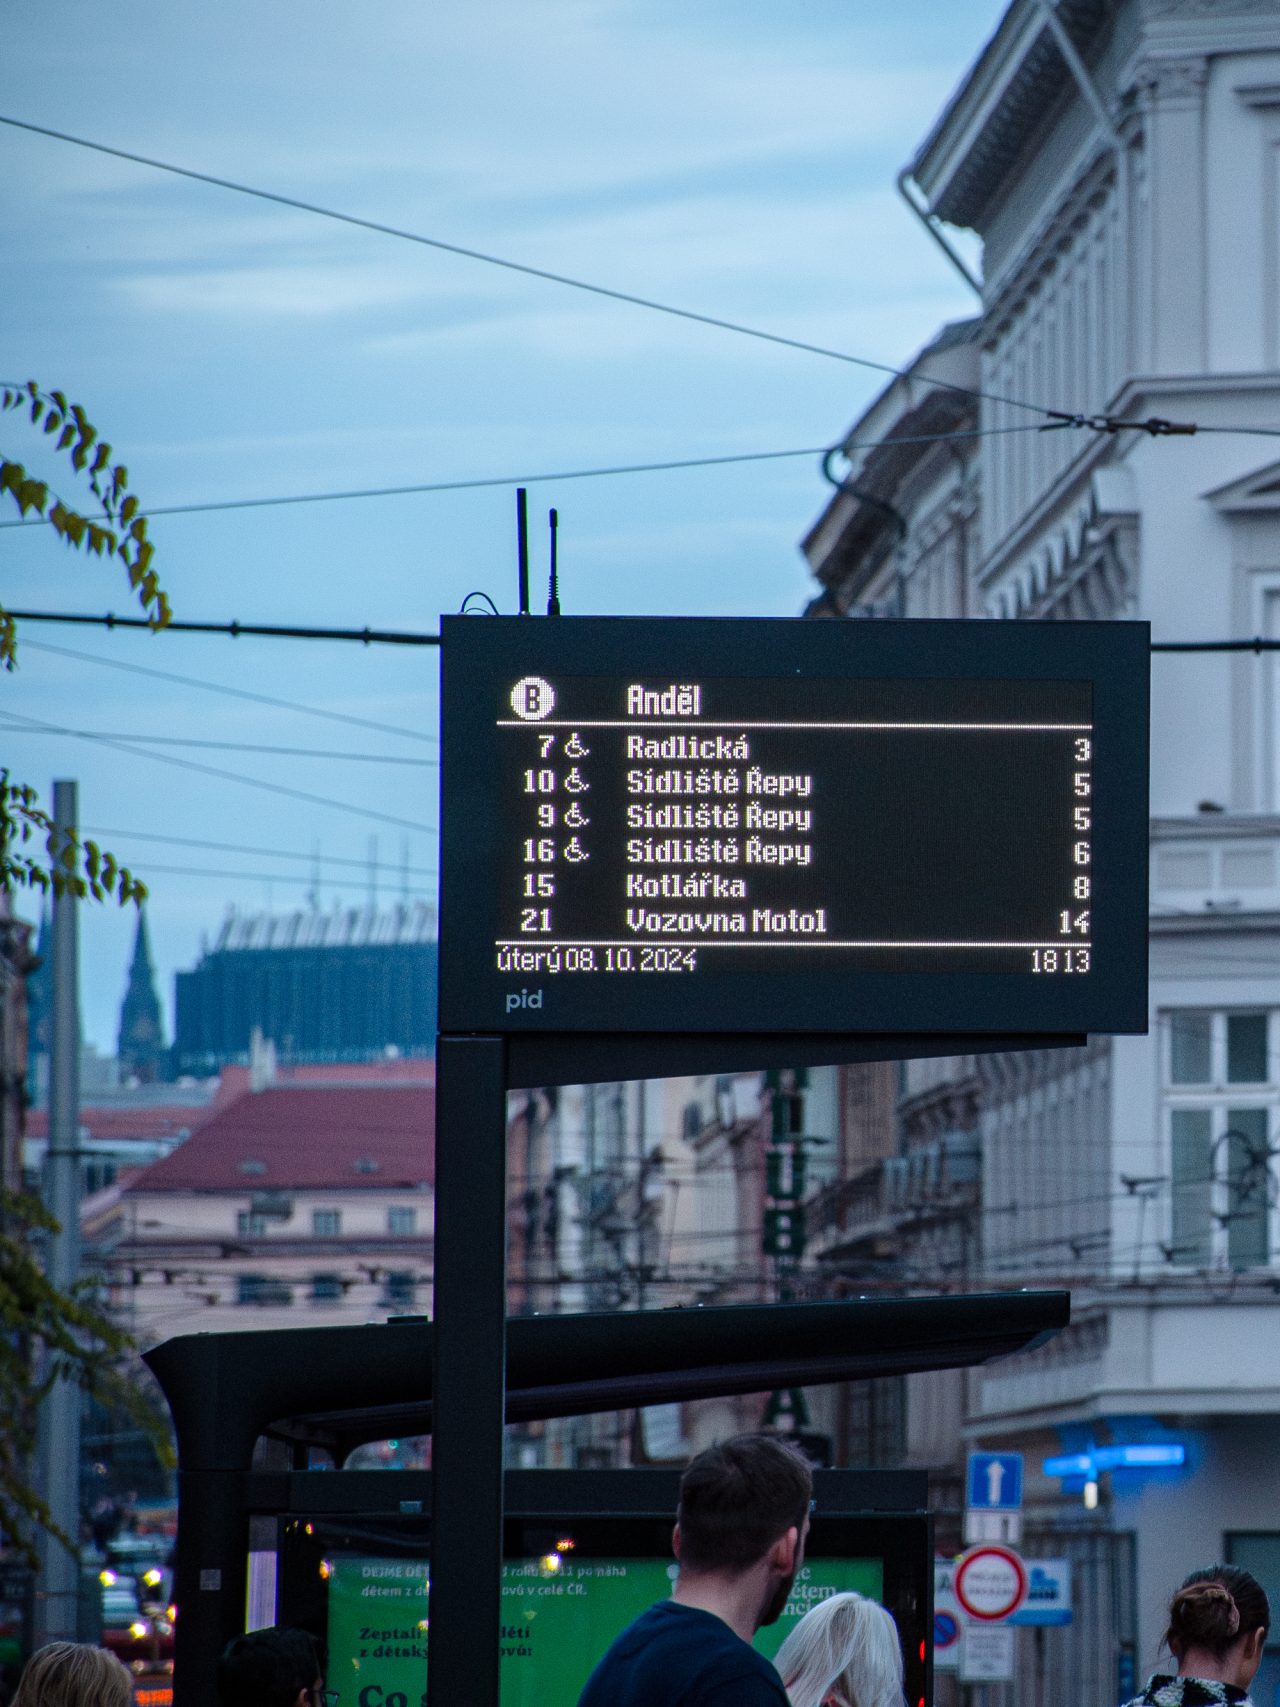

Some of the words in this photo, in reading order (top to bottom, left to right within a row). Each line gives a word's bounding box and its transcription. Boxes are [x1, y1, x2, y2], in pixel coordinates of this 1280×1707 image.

[524, 683, 541, 714] B
[627, 684, 701, 715] Anděl
[538, 735, 555, 758] 7
[627, 733, 750, 760] Radlická
[1074, 738, 1091, 761] 3
[524, 769, 555, 793] 10
[627, 767, 740, 794] Sídliště
[745, 766, 812, 797] Řepy
[1074, 773, 1091, 796] 5
[538, 804, 555, 828] 9
[627, 802, 740, 829] Sídliště
[745, 801, 812, 831] Řepy
[1074, 807, 1091, 831] 5
[523, 839, 555, 863] 16
[627, 837, 740, 864] Sídliště
[745, 835, 812, 866] Řepy
[1074, 841, 1091, 865] 6
[523, 873, 555, 898] 15
[626, 872, 747, 898] Kotlářka
[1074, 876, 1091, 899] 8
[520, 908, 552, 932] 21
[626, 908, 747, 933] Vozovna
[752, 908, 828, 933] Motol
[1060, 910, 1091, 934] 14
[496, 945, 561, 974] úterý
[640, 948, 698, 972] 2024
[505, 988, 544, 1013] pid
[405, 1563, 430, 1578] DĚT
[359, 1626, 422, 1642] Zeptali
[373, 1644, 429, 1660] dětský
